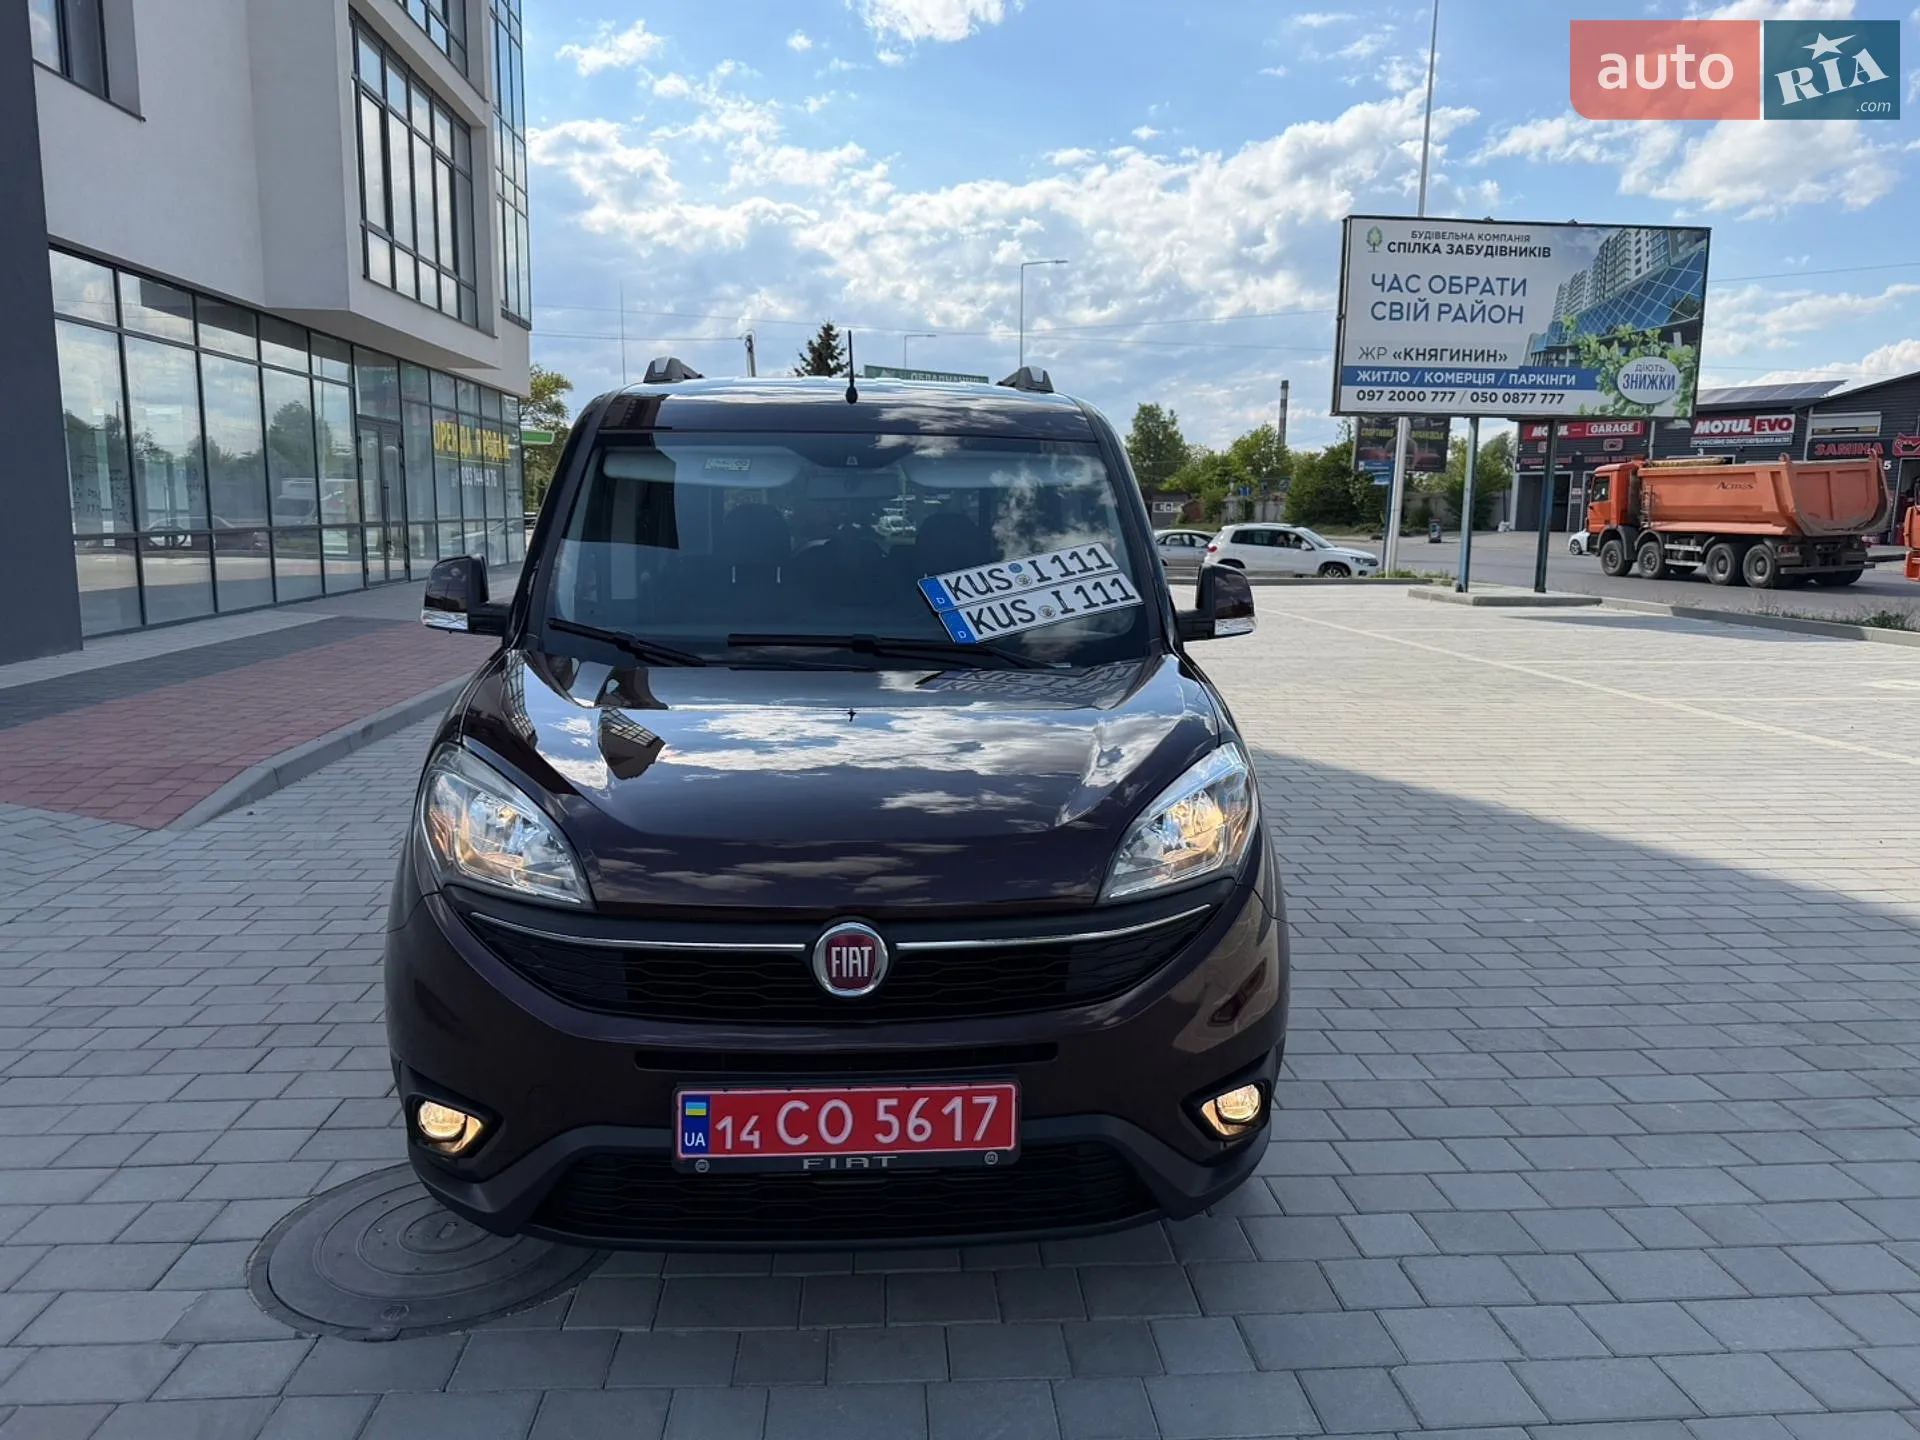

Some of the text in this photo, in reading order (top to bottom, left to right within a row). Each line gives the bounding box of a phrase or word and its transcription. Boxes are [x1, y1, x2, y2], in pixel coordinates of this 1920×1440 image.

[1411, 230, 1531, 243] БУДІВЕЛЬНА КОМПАНІЯ
[1387, 241, 1551, 258] СПІЛКА ЗАБУДІВНИКІВ
[1371, 273, 1528, 297] ЧАС ОБРАТИ
[1371, 298, 1524, 325] СВІЙ РАЙОН
[1358, 346, 1508, 363] ЖР «КНЯГИНИН»
[1634, 363, 1666, 373] ДІЮТЬ
[1356, 370, 1411, 383] ЖИТЛО
[1424, 371, 1495, 387] КОМЕРЦІЯ
[1508, 373, 1577, 386] ПАРКІНГИ
[1622, 373, 1676, 390] ЗНИЖКИ
[1356, 389, 1384, 402] 097
[1388, 390, 1427, 402] 2000
[1430, 391, 1456, 403] 777
[1470, 392, 1498, 404] 050
[1502, 392, 1537, 404] 0877
[1540, 393, 1565, 405] 777
[1531, 422, 1635, 437] MOUL GARAGE
[1694, 417, 1793, 435] MOTUL EVO
[1883, 460, 1892, 470] 5
[944, 547, 1112, 601] KUS I 111
[966, 577, 1136, 635] KUS I 111
[957, 630, 967, 639] D
[831, 946, 873, 978] FIAT
[684, 1095, 999, 1150] UA 14 CO 5617
[802, 1156, 898, 1170] FIAT
